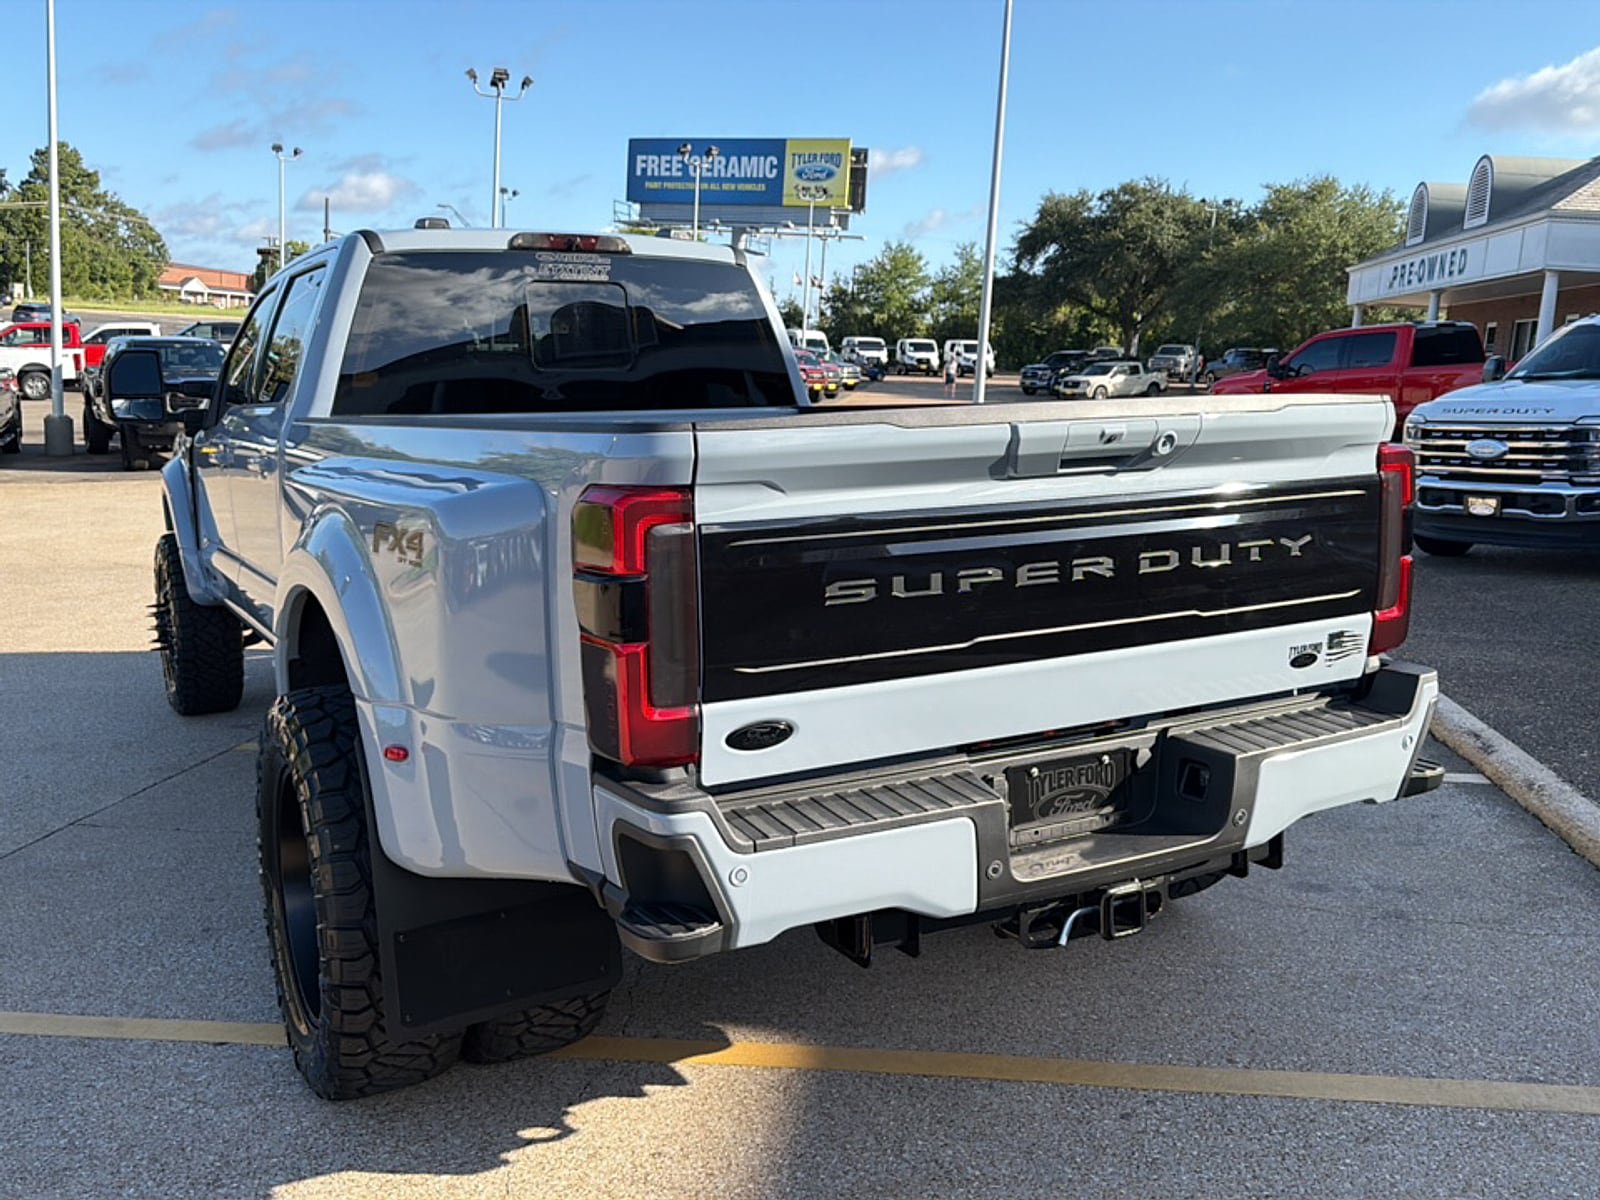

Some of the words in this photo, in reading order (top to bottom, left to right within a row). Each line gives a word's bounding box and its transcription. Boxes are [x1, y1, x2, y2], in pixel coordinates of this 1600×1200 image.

[635, 154, 683, 177] FREE
[688, 155, 778, 179] CERAMIC
[791, 152, 818, 169] TYLER
[820, 152, 842, 168] FORD
[801, 167, 828, 180] Ford
[1388, 248, 1467, 289] PRE-OWNED
[1441, 407, 1499, 415] SUPER
[1502, 407, 1555, 415] DUTY
[372, 522, 424, 559] FX4
[824, 555, 1115, 606] SUPER
[1137, 534, 1313, 575] DUTY
[1025, 768, 1075, 808] TYLER
[1076, 758, 1116, 790] FORD
[1049, 792, 1097, 815] Ford
